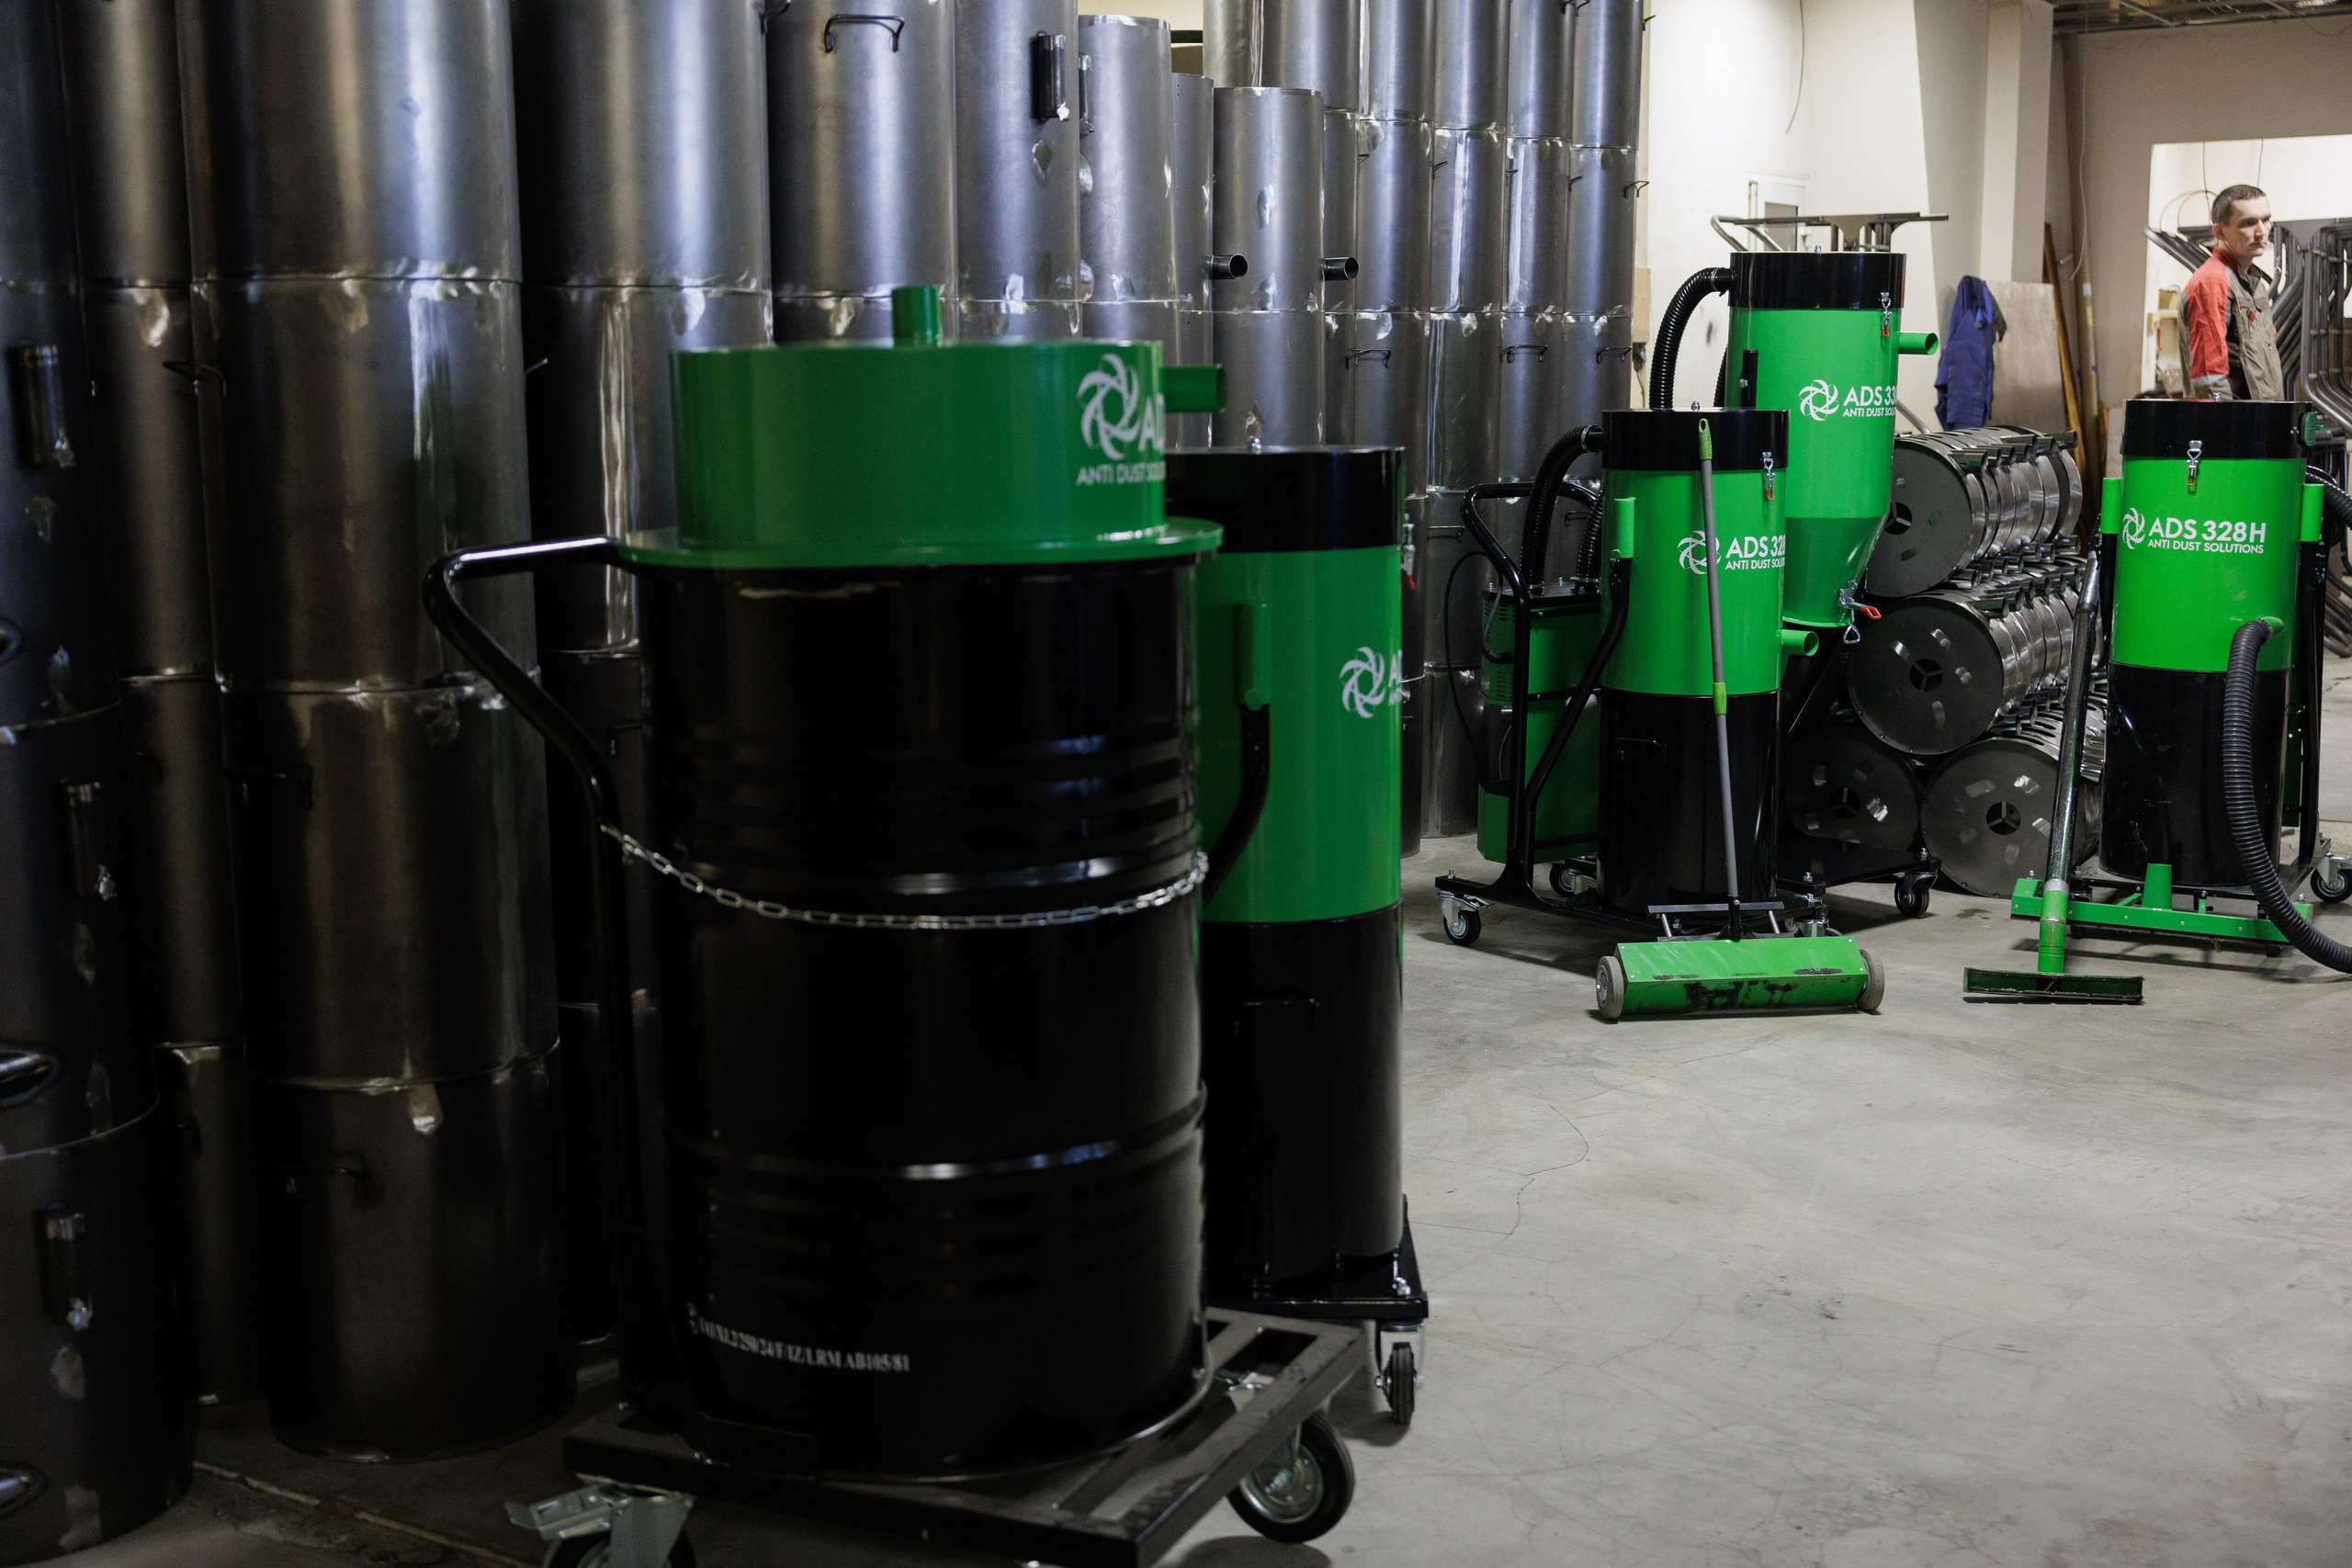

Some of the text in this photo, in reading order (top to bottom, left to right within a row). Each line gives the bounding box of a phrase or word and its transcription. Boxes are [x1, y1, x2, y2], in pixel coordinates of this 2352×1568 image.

[1842, 386, 1883, 407] ADS
[1842, 407, 1865, 418] ANTI
[1866, 407, 1885, 417] DUST
[2148, 516, 2198, 540] ADS
[1725, 536, 1769, 558] ADS
[2147, 538, 2265, 554] ANTI DUST SOLUTIONS
[1724, 559, 1749, 570] ANTI
[1750, 558, 1771, 570] DUST
